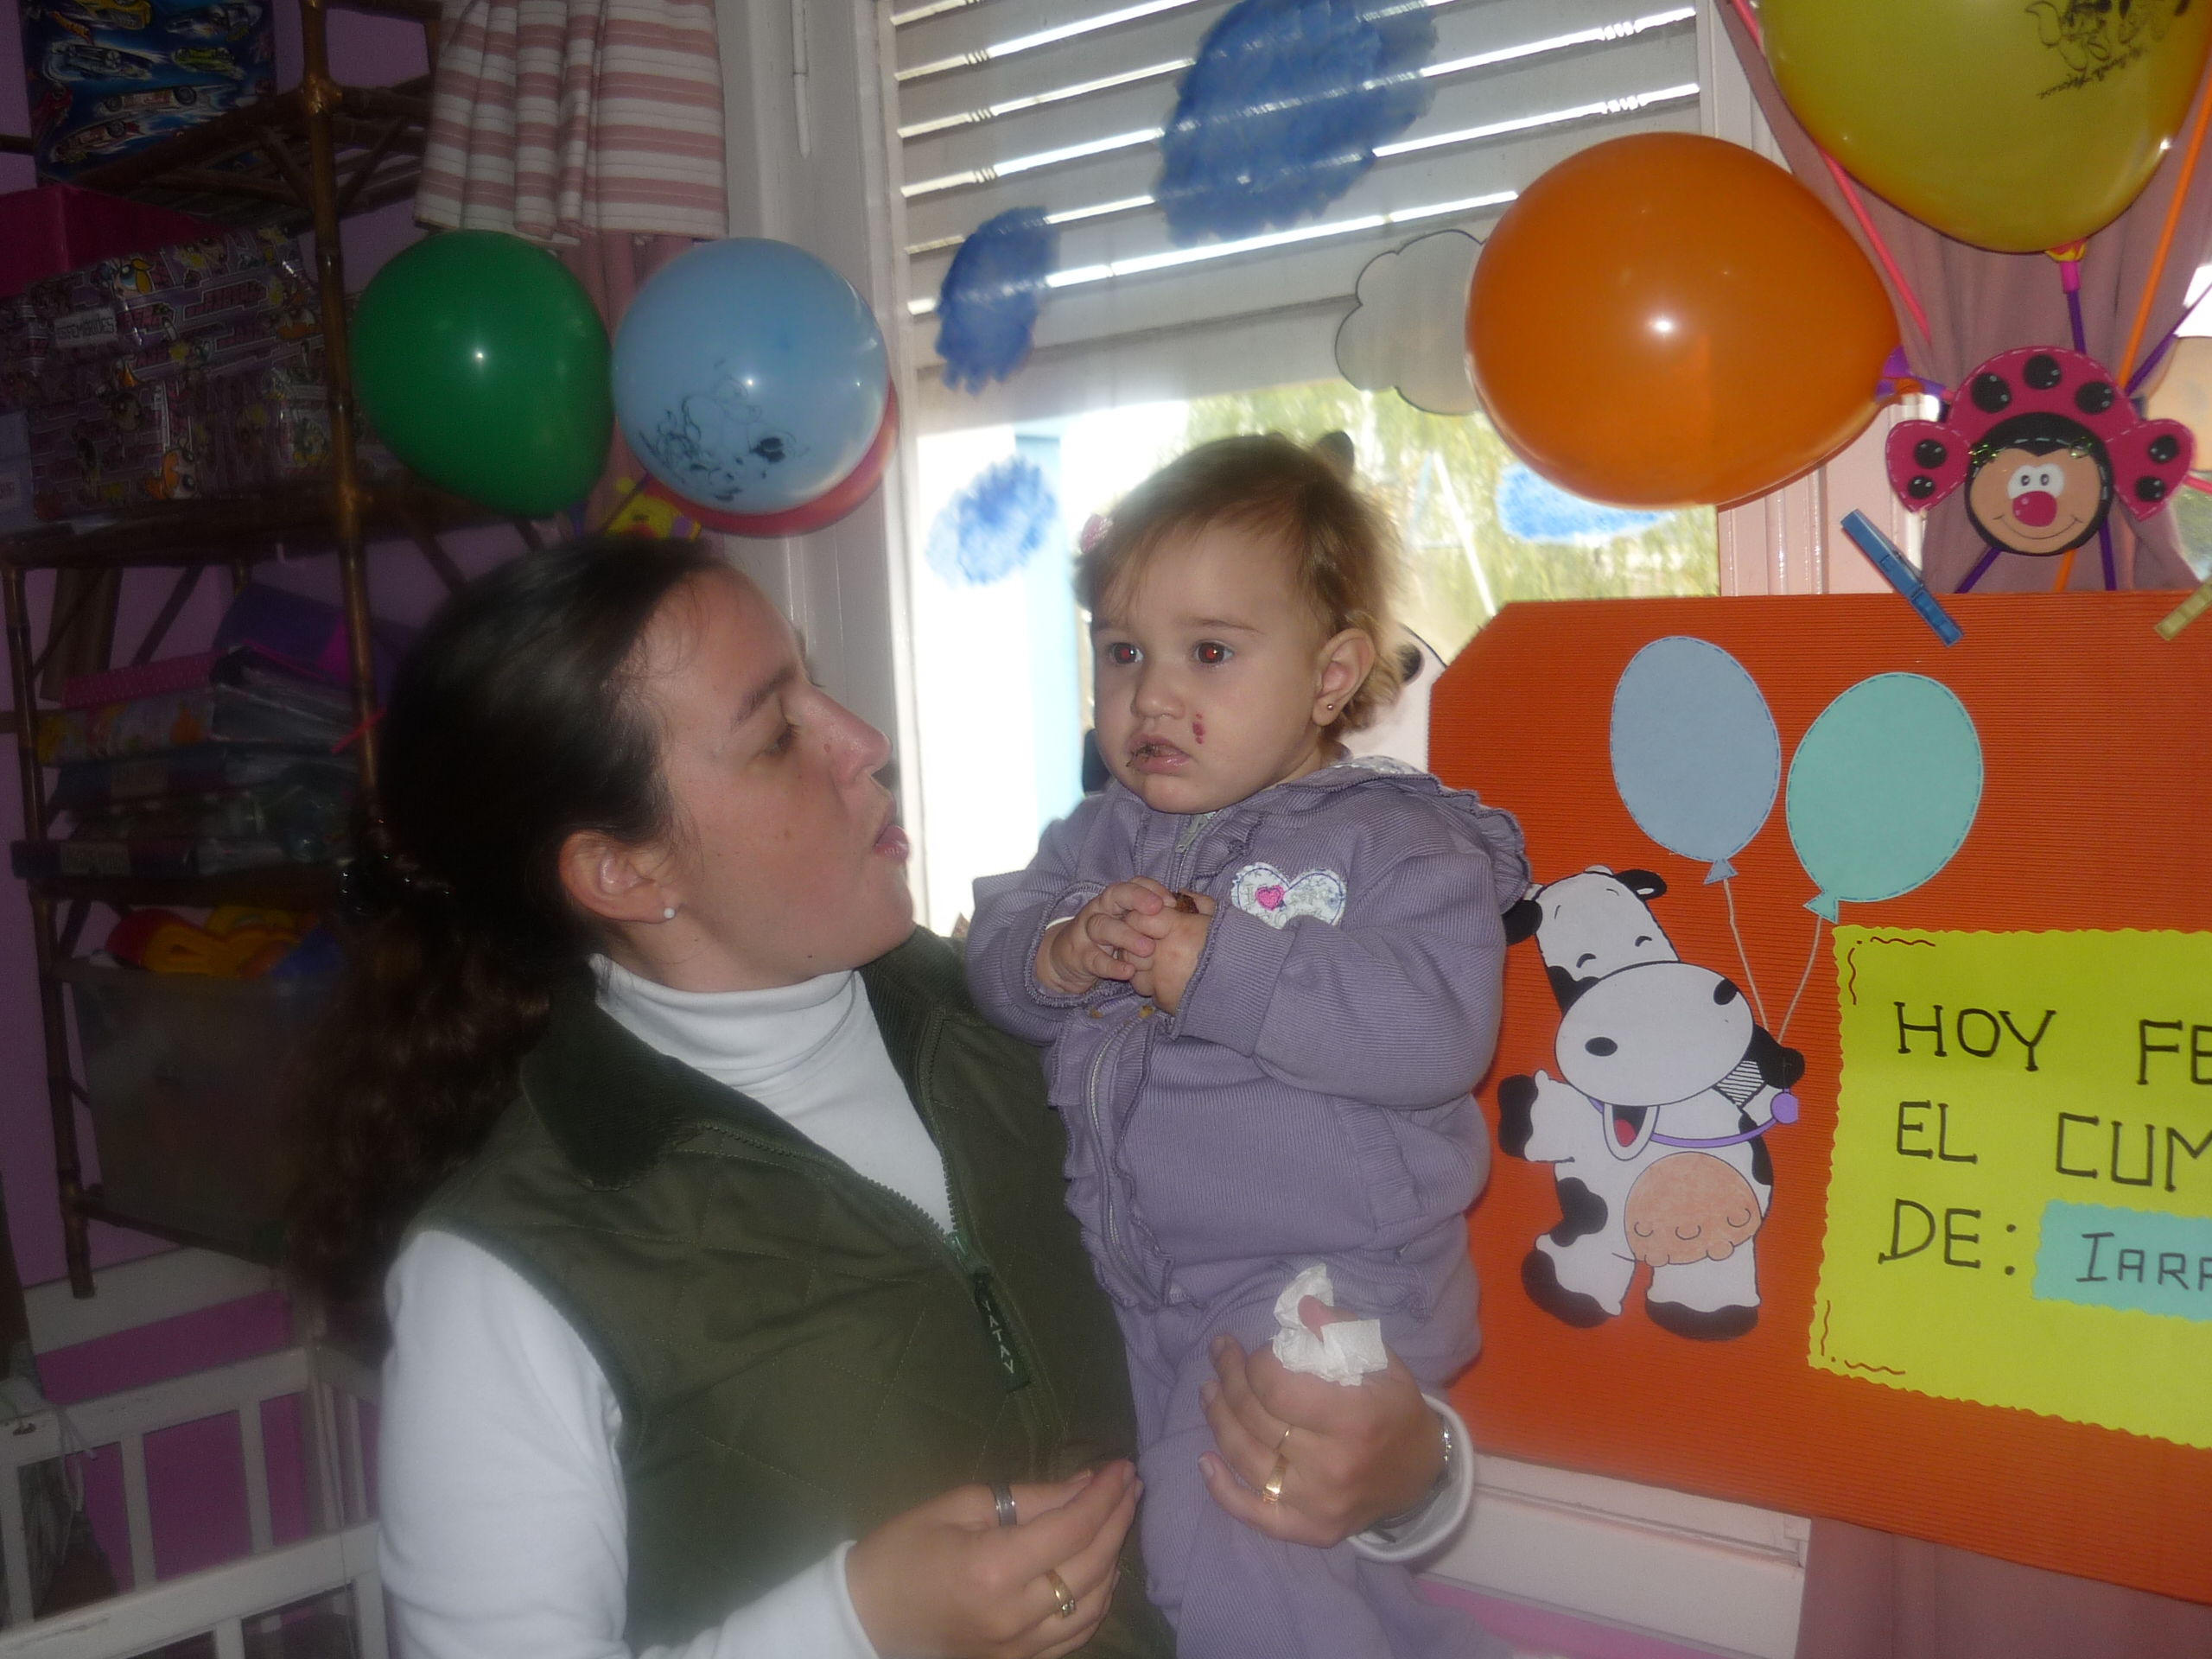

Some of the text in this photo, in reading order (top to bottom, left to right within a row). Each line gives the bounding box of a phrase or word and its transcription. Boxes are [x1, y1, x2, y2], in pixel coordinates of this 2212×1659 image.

[1894, 1001, 2212, 1086] HOY FE
[1895, 1100, 2212, 1193] EL CUM
[1878, 1198, 2017, 1275] DE:
